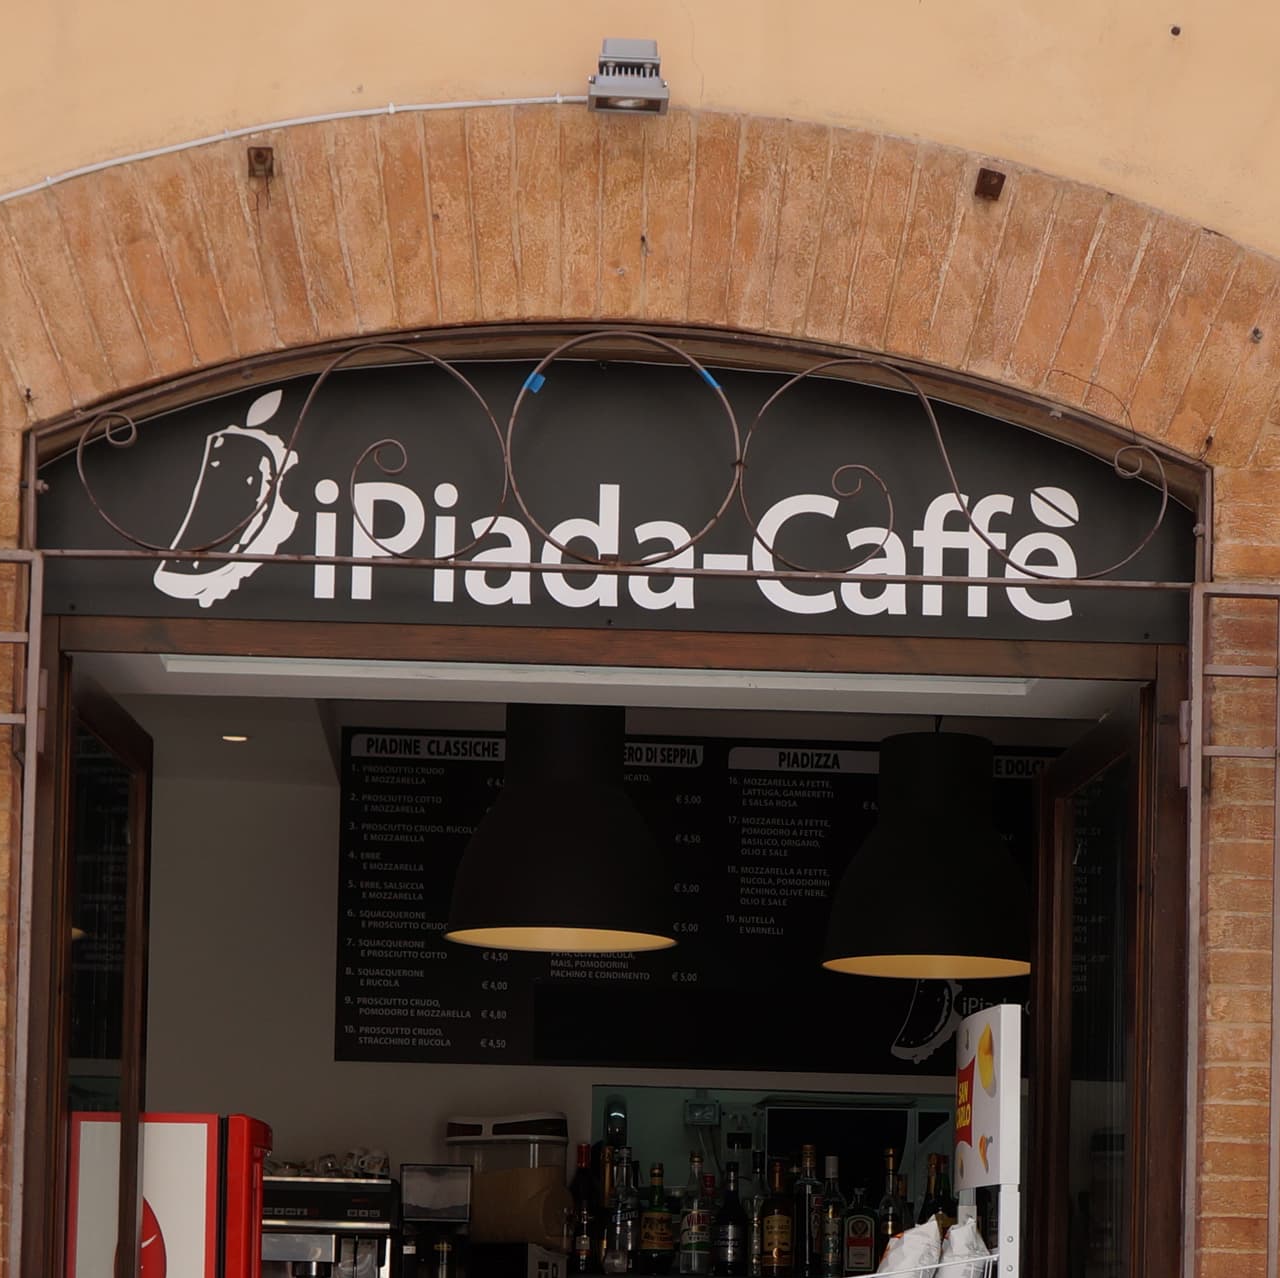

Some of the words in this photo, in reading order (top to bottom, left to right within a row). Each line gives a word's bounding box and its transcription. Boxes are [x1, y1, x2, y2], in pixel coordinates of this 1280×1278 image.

[367, 738, 420, 754] PIADINE
[428, 740, 499, 757] CLASSICHE
[647, 747, 656, 763] DI
[660, 748, 698, 765] SEPPIA
[779, 752, 840, 769] PIADIZZA
[1006, 760, 1044, 776] DOLC
[743, 777, 797, 787] MOZZARELLA
[742, 817, 795, 826] MOZZARELLA
[370, 834, 424, 842] MOZZARELLA
[369, 864, 424, 872] MOZZARELLA
[741, 867, 794, 875] MOZZARELLA
[368, 892, 423, 900] MOZZARELLA
[739, 916, 775, 924] NUTELLA
[745, 927, 784, 935] VARNELLI
[420, 952, 447, 960] COTTO
[575, 960, 628, 968] POMODORINI
[551, 970, 586, 978] PACHINO
[595, 971, 649, 980] CONDIMENTO
[357, 998, 408, 1006] PROSCIUTTO
[417, 1010, 471, 1018] MOZZARELLA
[359, 1027, 411, 1035] PROSCIUTTO
[358, 1037, 410, 1045] STRACCHINO
[419, 1039, 451, 1047] RUCOLA
